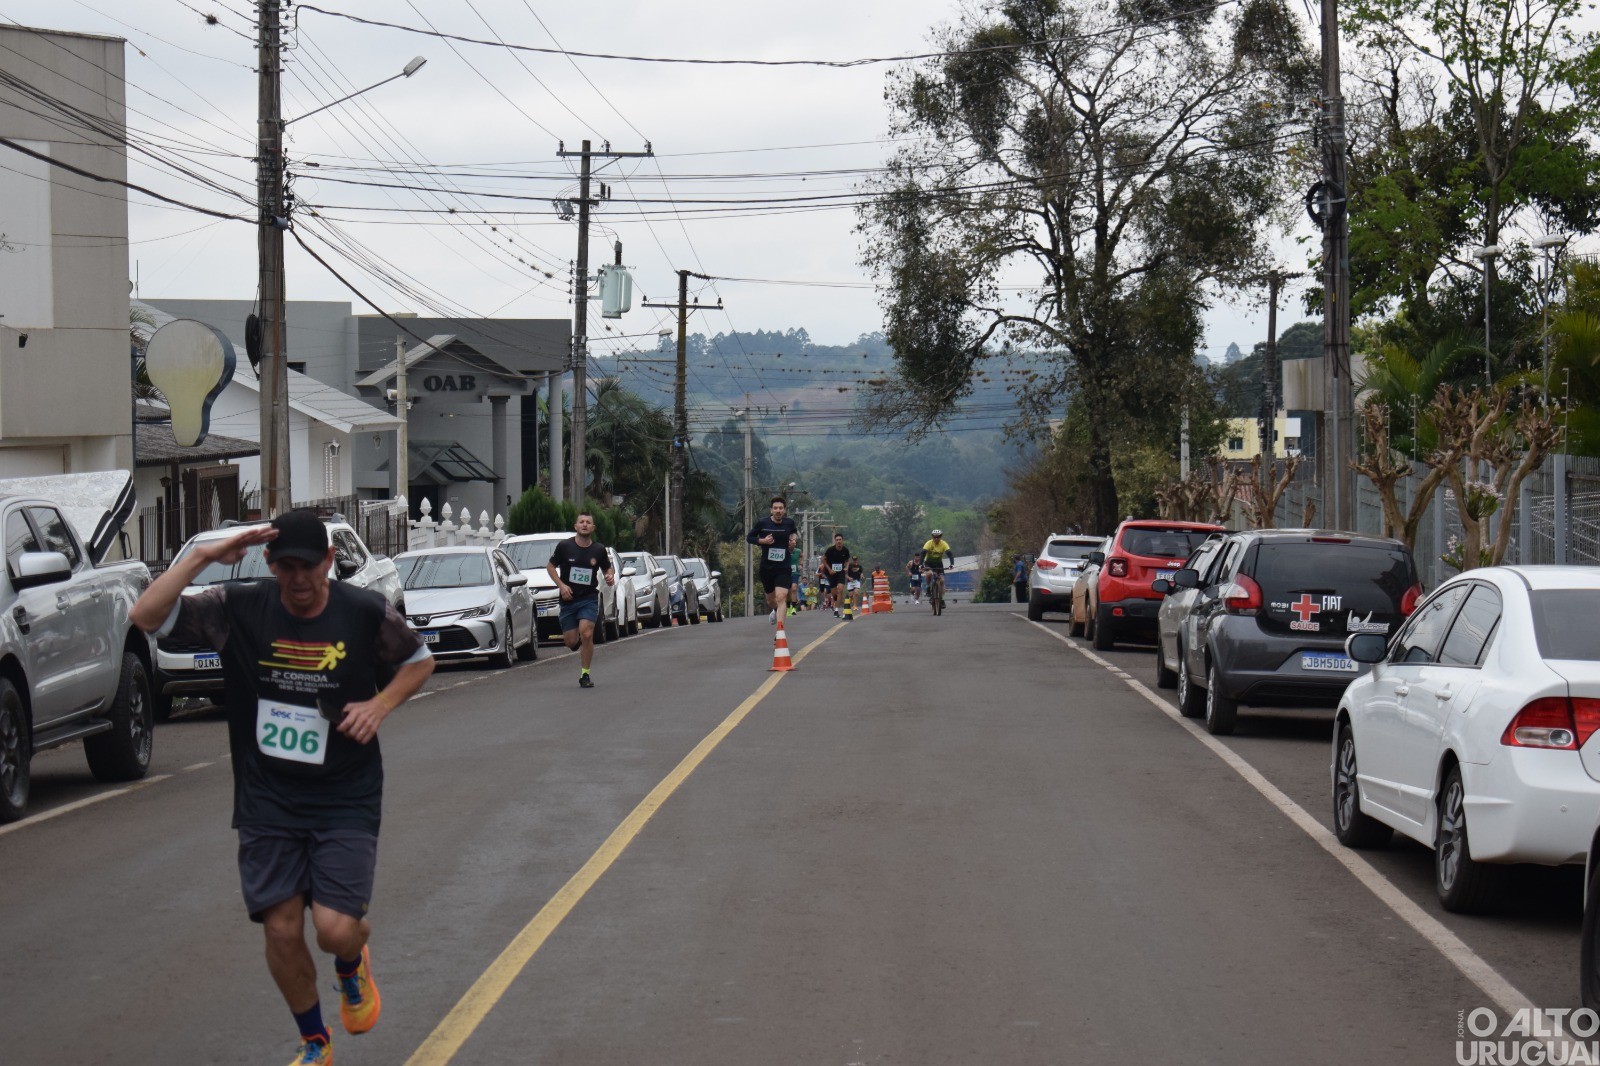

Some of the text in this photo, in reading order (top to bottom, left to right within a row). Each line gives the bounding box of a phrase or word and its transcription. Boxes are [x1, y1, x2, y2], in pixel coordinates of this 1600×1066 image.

[423, 374, 476, 392] OAB
[769, 552, 784, 560] 204
[572, 573, 590, 582] 128
[1322, 595, 1343, 611] FIAT
[197, 658, 220, 669] QIN3
[283, 672, 328, 682] CORRIDA
[260, 723, 320, 754] 206
